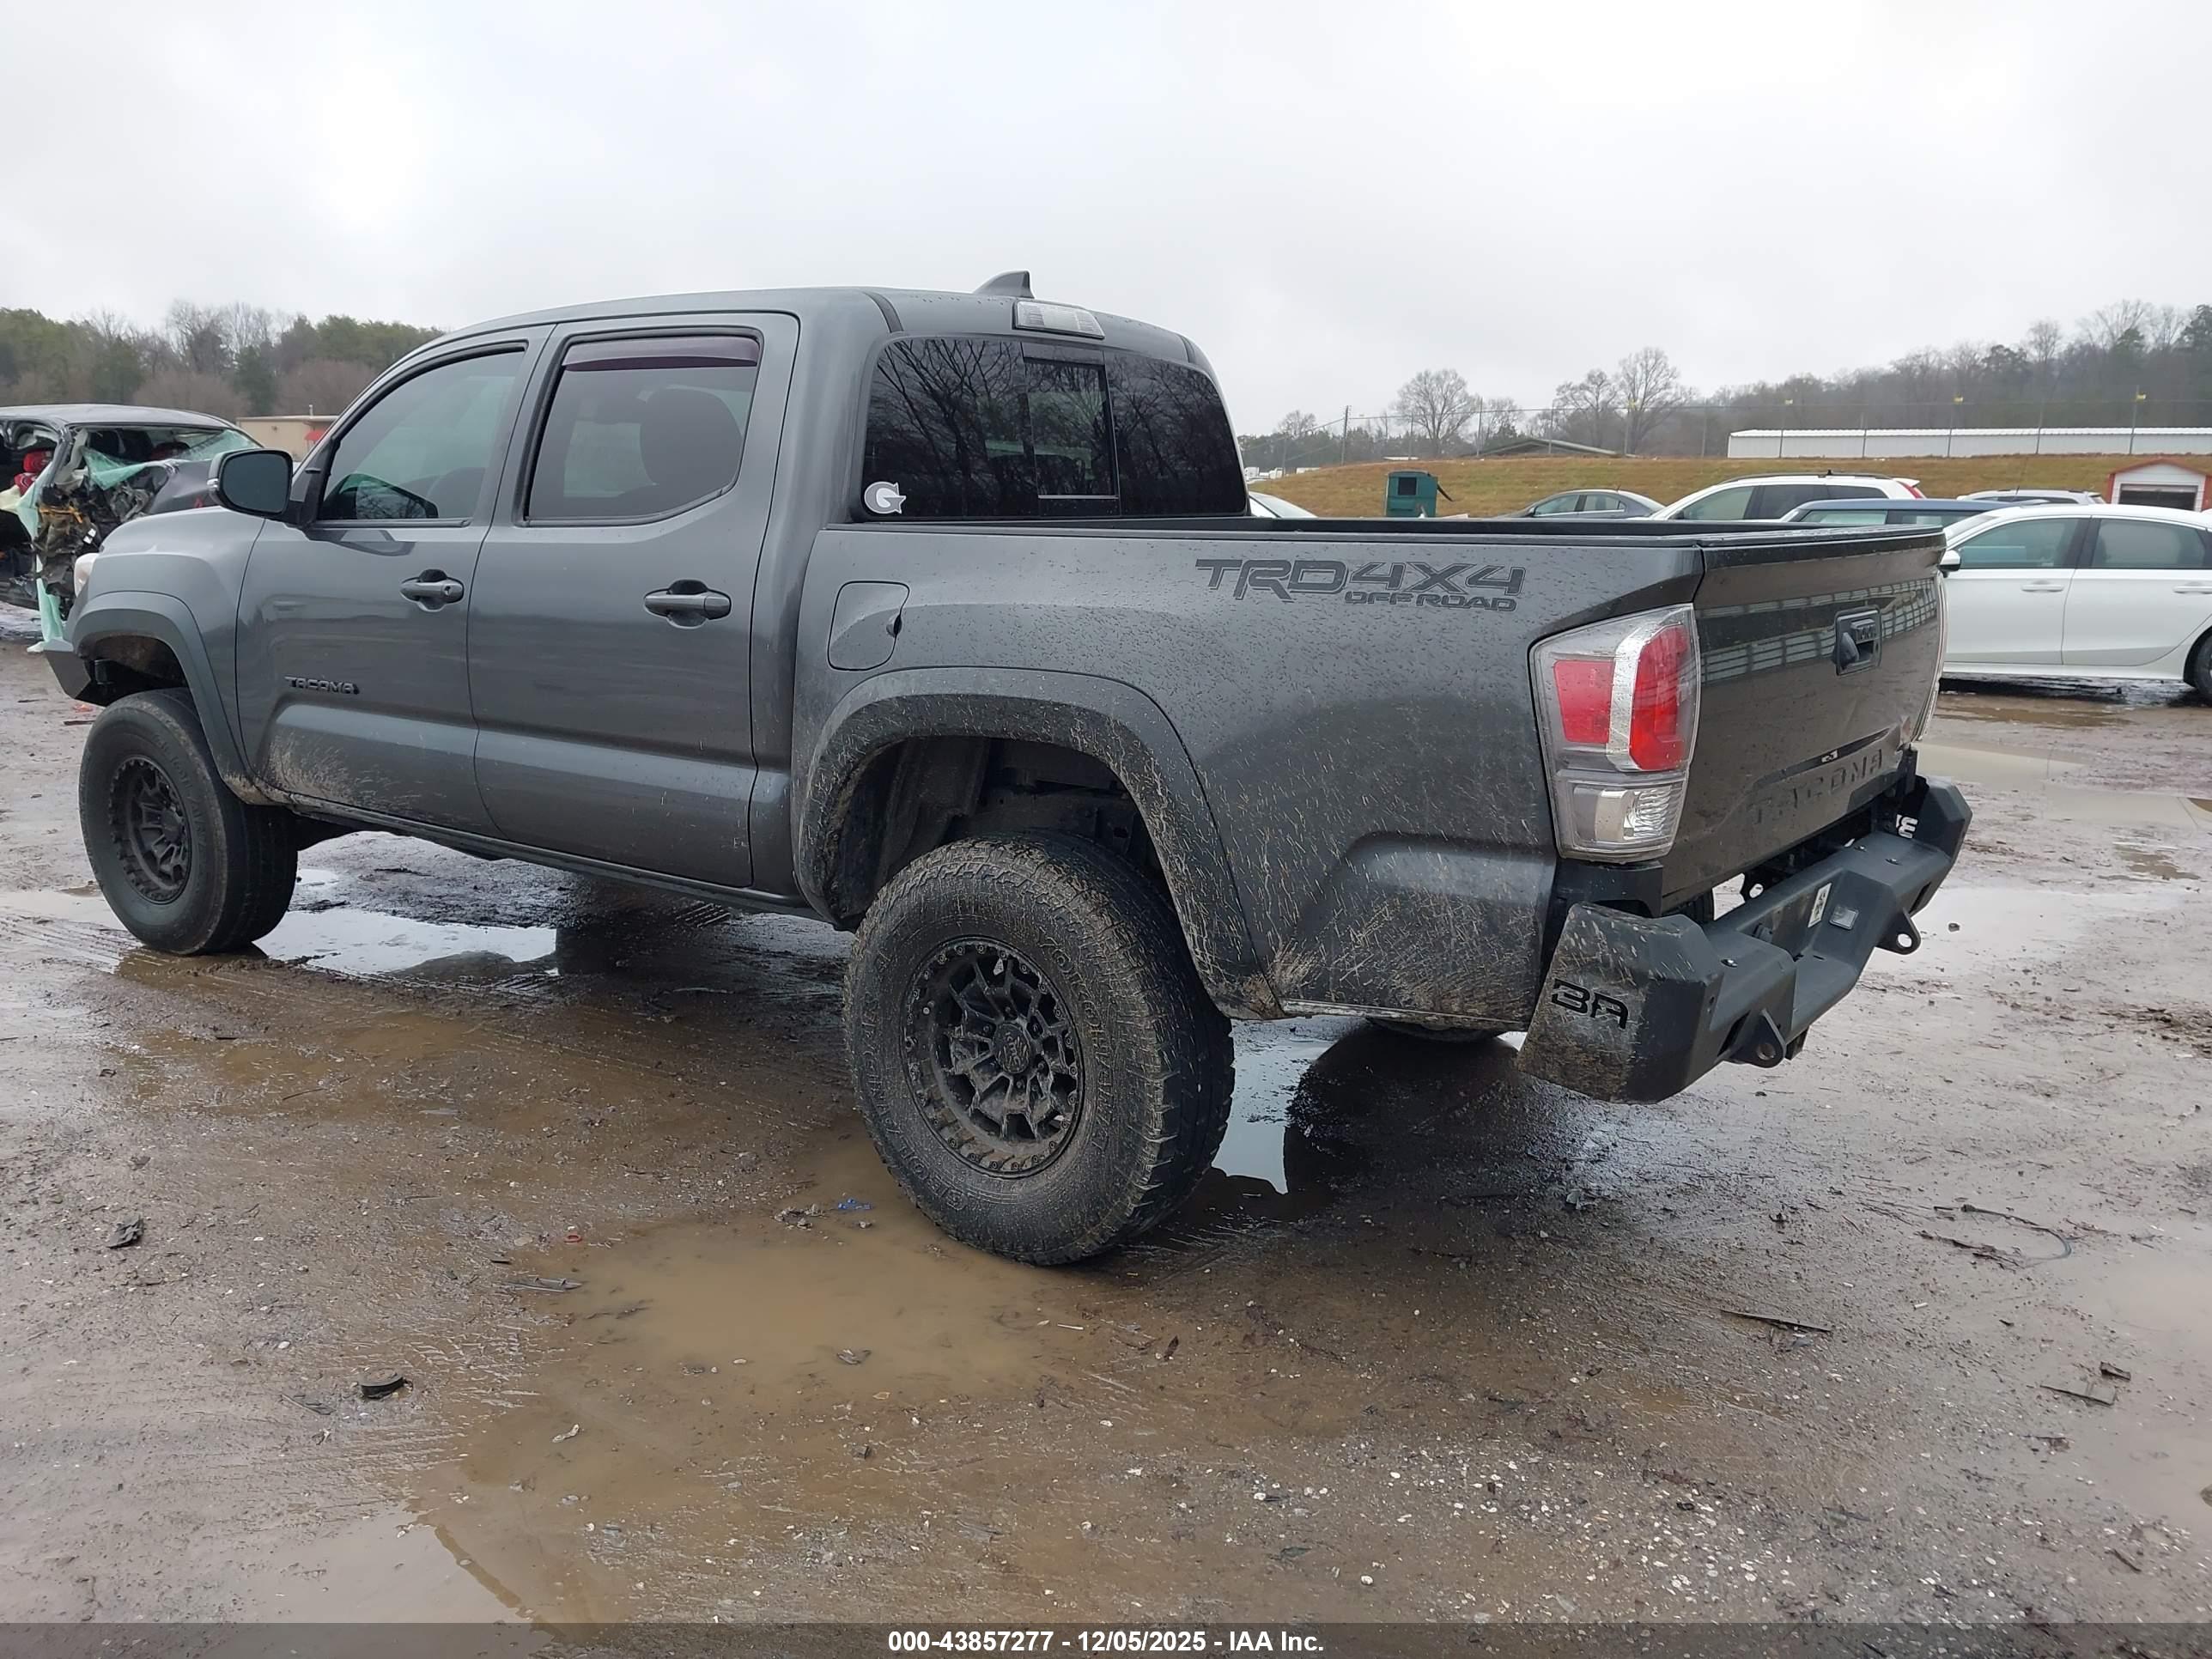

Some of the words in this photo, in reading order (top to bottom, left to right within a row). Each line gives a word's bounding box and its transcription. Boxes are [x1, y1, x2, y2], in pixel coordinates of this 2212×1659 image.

[864, 481, 907, 514] G
[1195, 559, 1349, 603] TRD
[1344, 590, 1414, 605] OFF
[1416, 593, 1517, 612] ROAD
[284, 675, 360, 695] TACOMA
